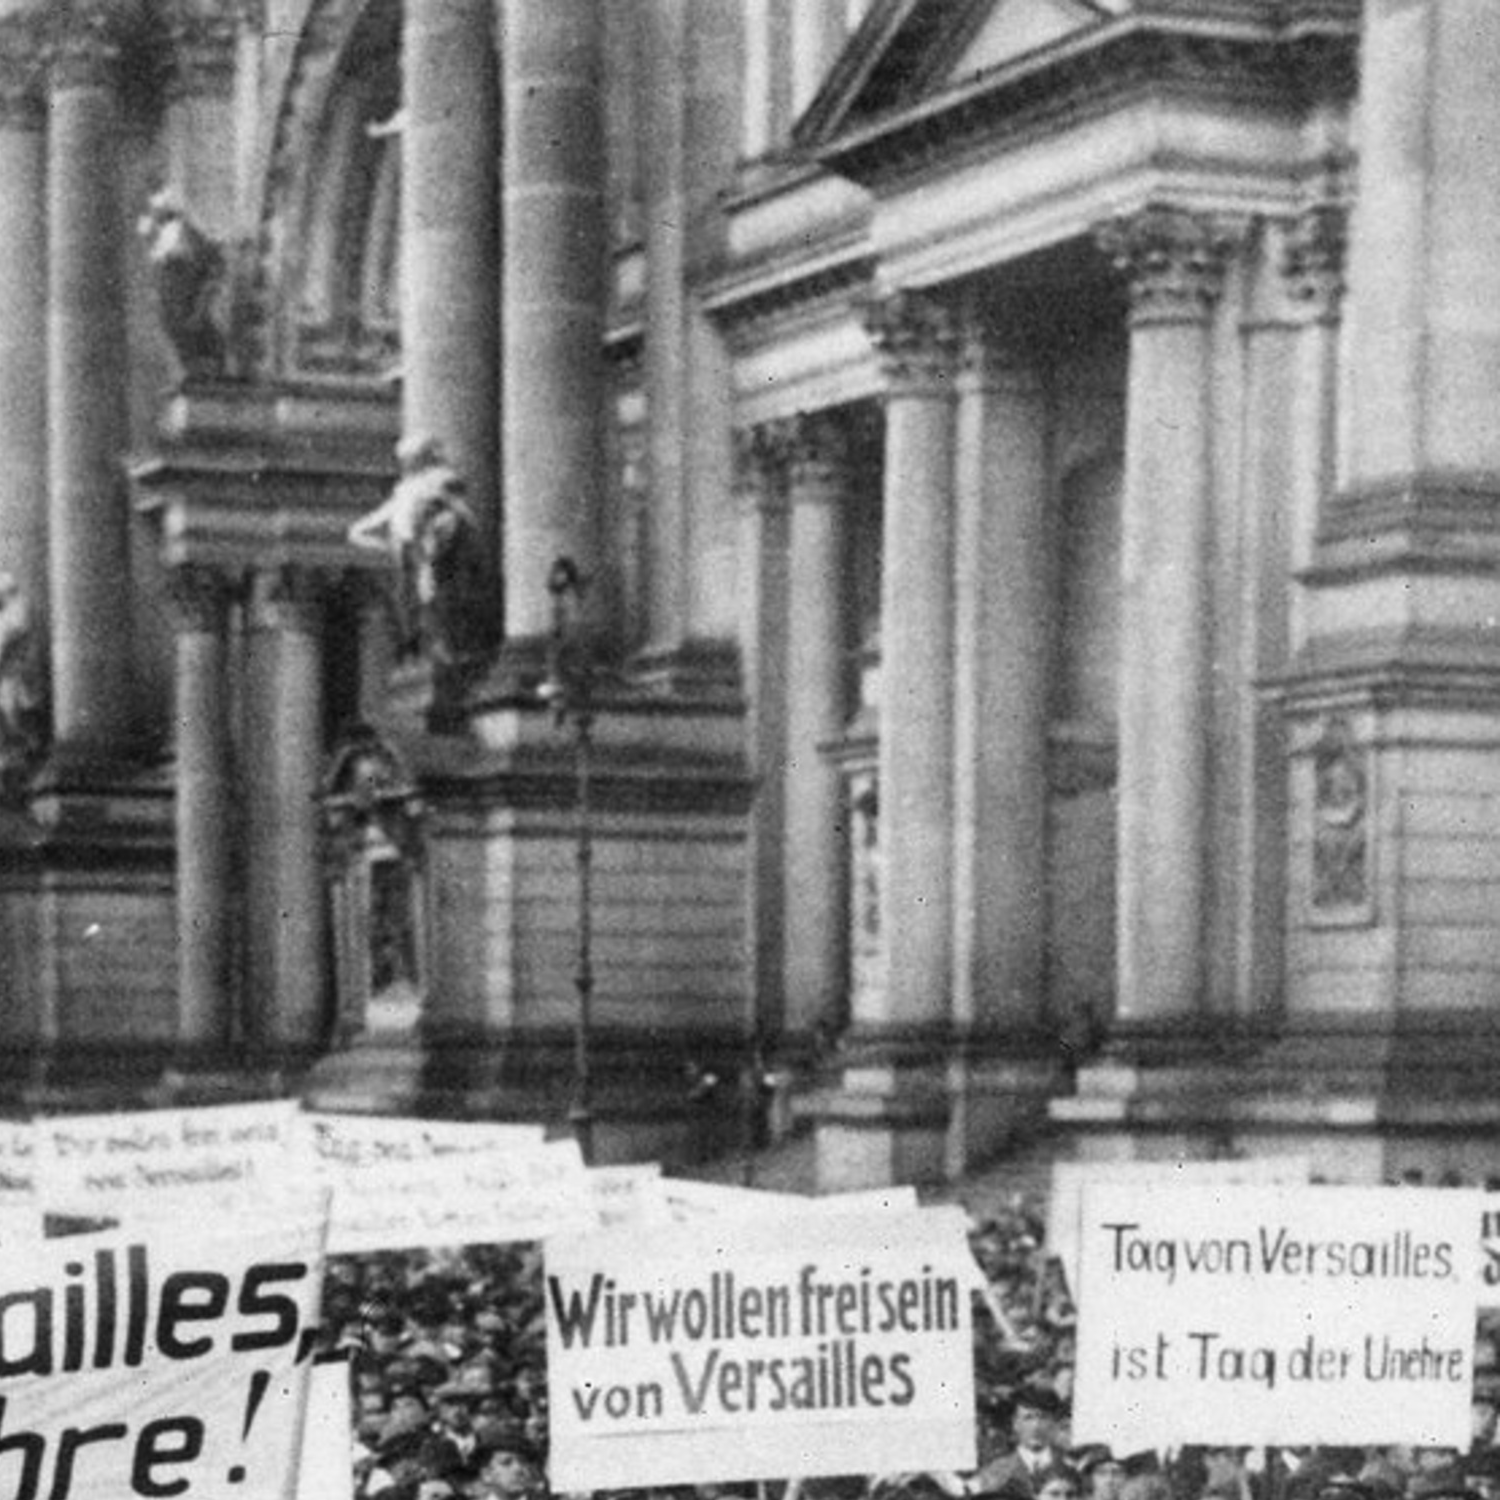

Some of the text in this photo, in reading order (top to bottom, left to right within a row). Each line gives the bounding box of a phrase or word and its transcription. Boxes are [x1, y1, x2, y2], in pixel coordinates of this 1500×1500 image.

[1100, 1222, 1178, 1286] Tag
[1183, 1239, 1252, 1275] von
[547, 1264, 959, 1350] Wir wollen frei sein
[572, 1338, 916, 1421] von Versailles
[1111, 1331, 1464, 1391] ist Tag der Unehre
